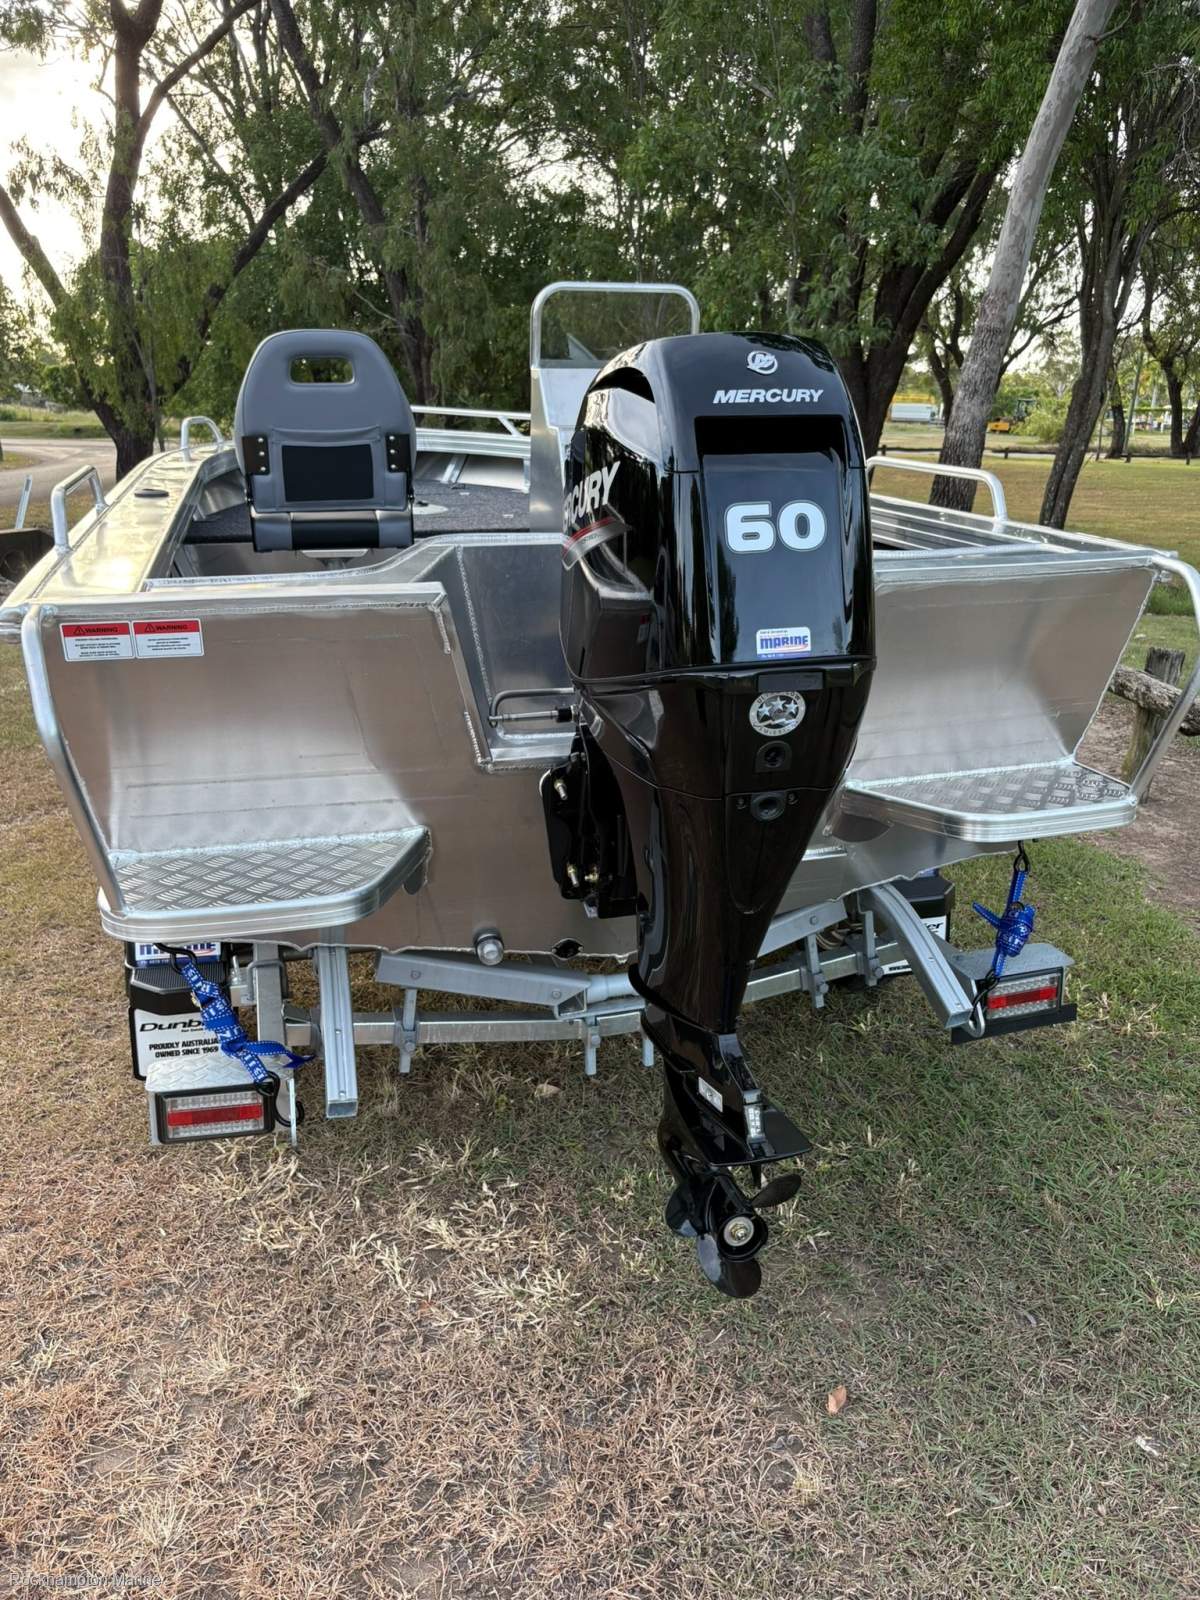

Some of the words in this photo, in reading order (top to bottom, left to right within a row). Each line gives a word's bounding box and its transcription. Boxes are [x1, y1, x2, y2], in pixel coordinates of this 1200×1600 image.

[712, 388, 824, 404] MERCURY
[562, 460, 621, 533] RCURY
[724, 499, 827, 554] 60
[760, 635, 808, 649] MARINE
[140, 1018, 204, 1032] Dunb
[149, 1041, 179, 1051] PROUDLY
[181, 1037, 219, 1048] AUSTRALIA
[155, 1048, 180, 1058] OWNED
[181, 1047, 201, 1056] SINCE
[202, 1045, 219, 1055] 1969
